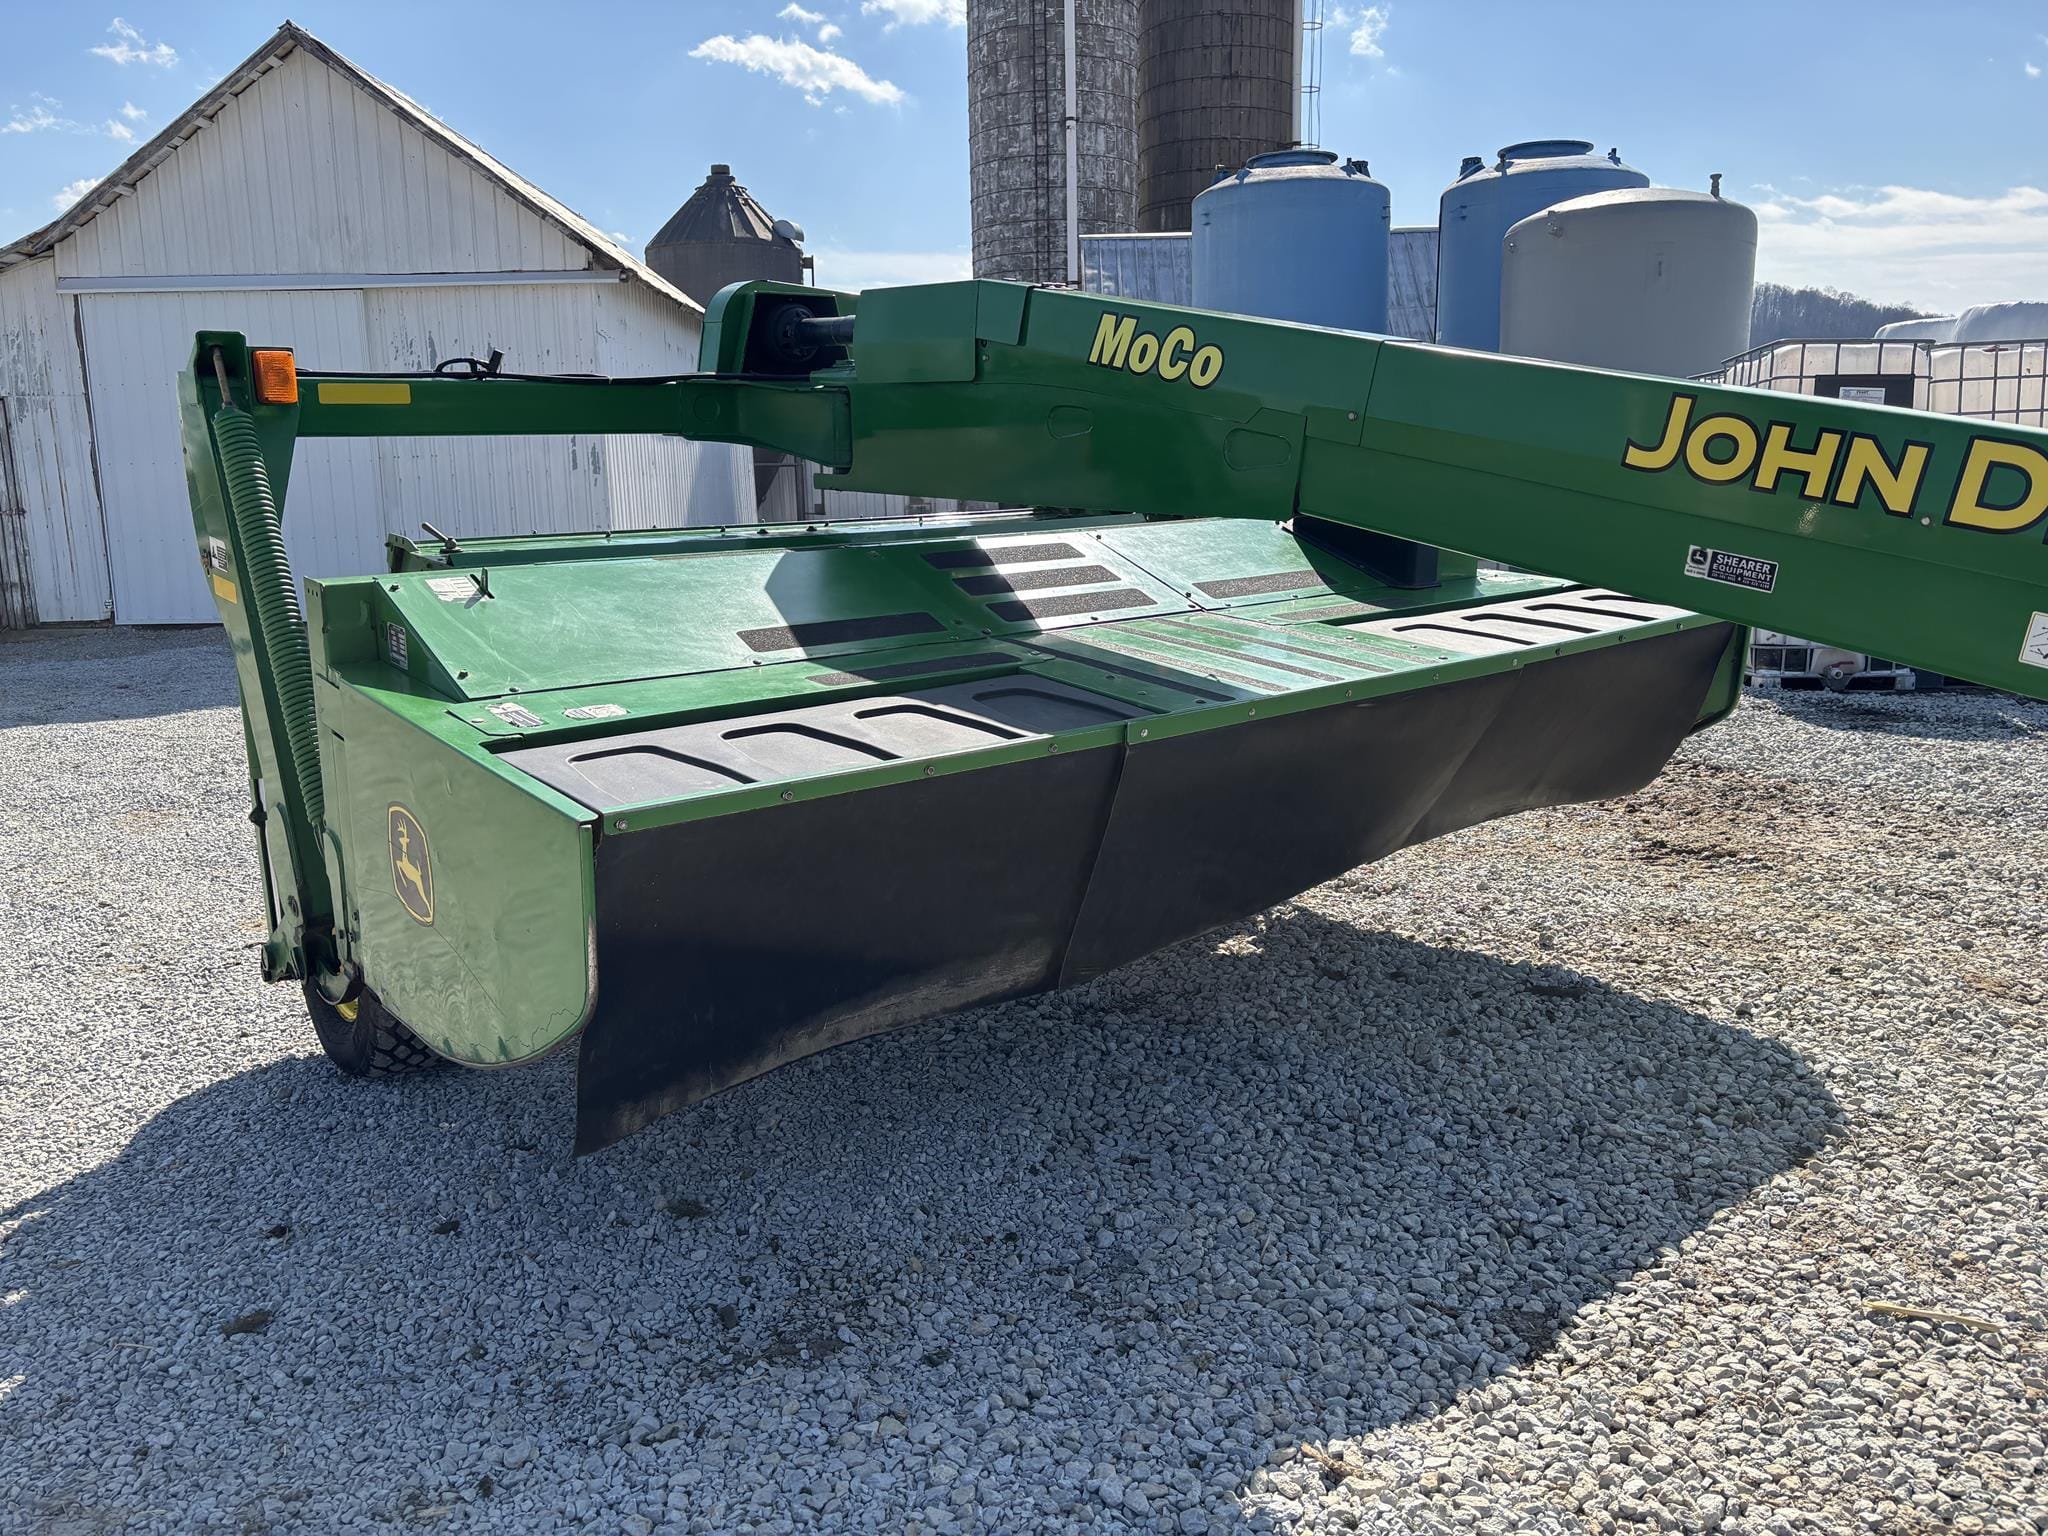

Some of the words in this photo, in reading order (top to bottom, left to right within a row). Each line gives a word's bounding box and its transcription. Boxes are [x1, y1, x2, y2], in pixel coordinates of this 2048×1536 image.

[1087, 311, 1224, 389] MoCo
[1622, 393, 1935, 518] JOHN
[1943, 435, 2048, 544] D
[1712, 563, 1773, 582] EQUIPMENT
[1716, 554, 1771, 574] SHEARER
